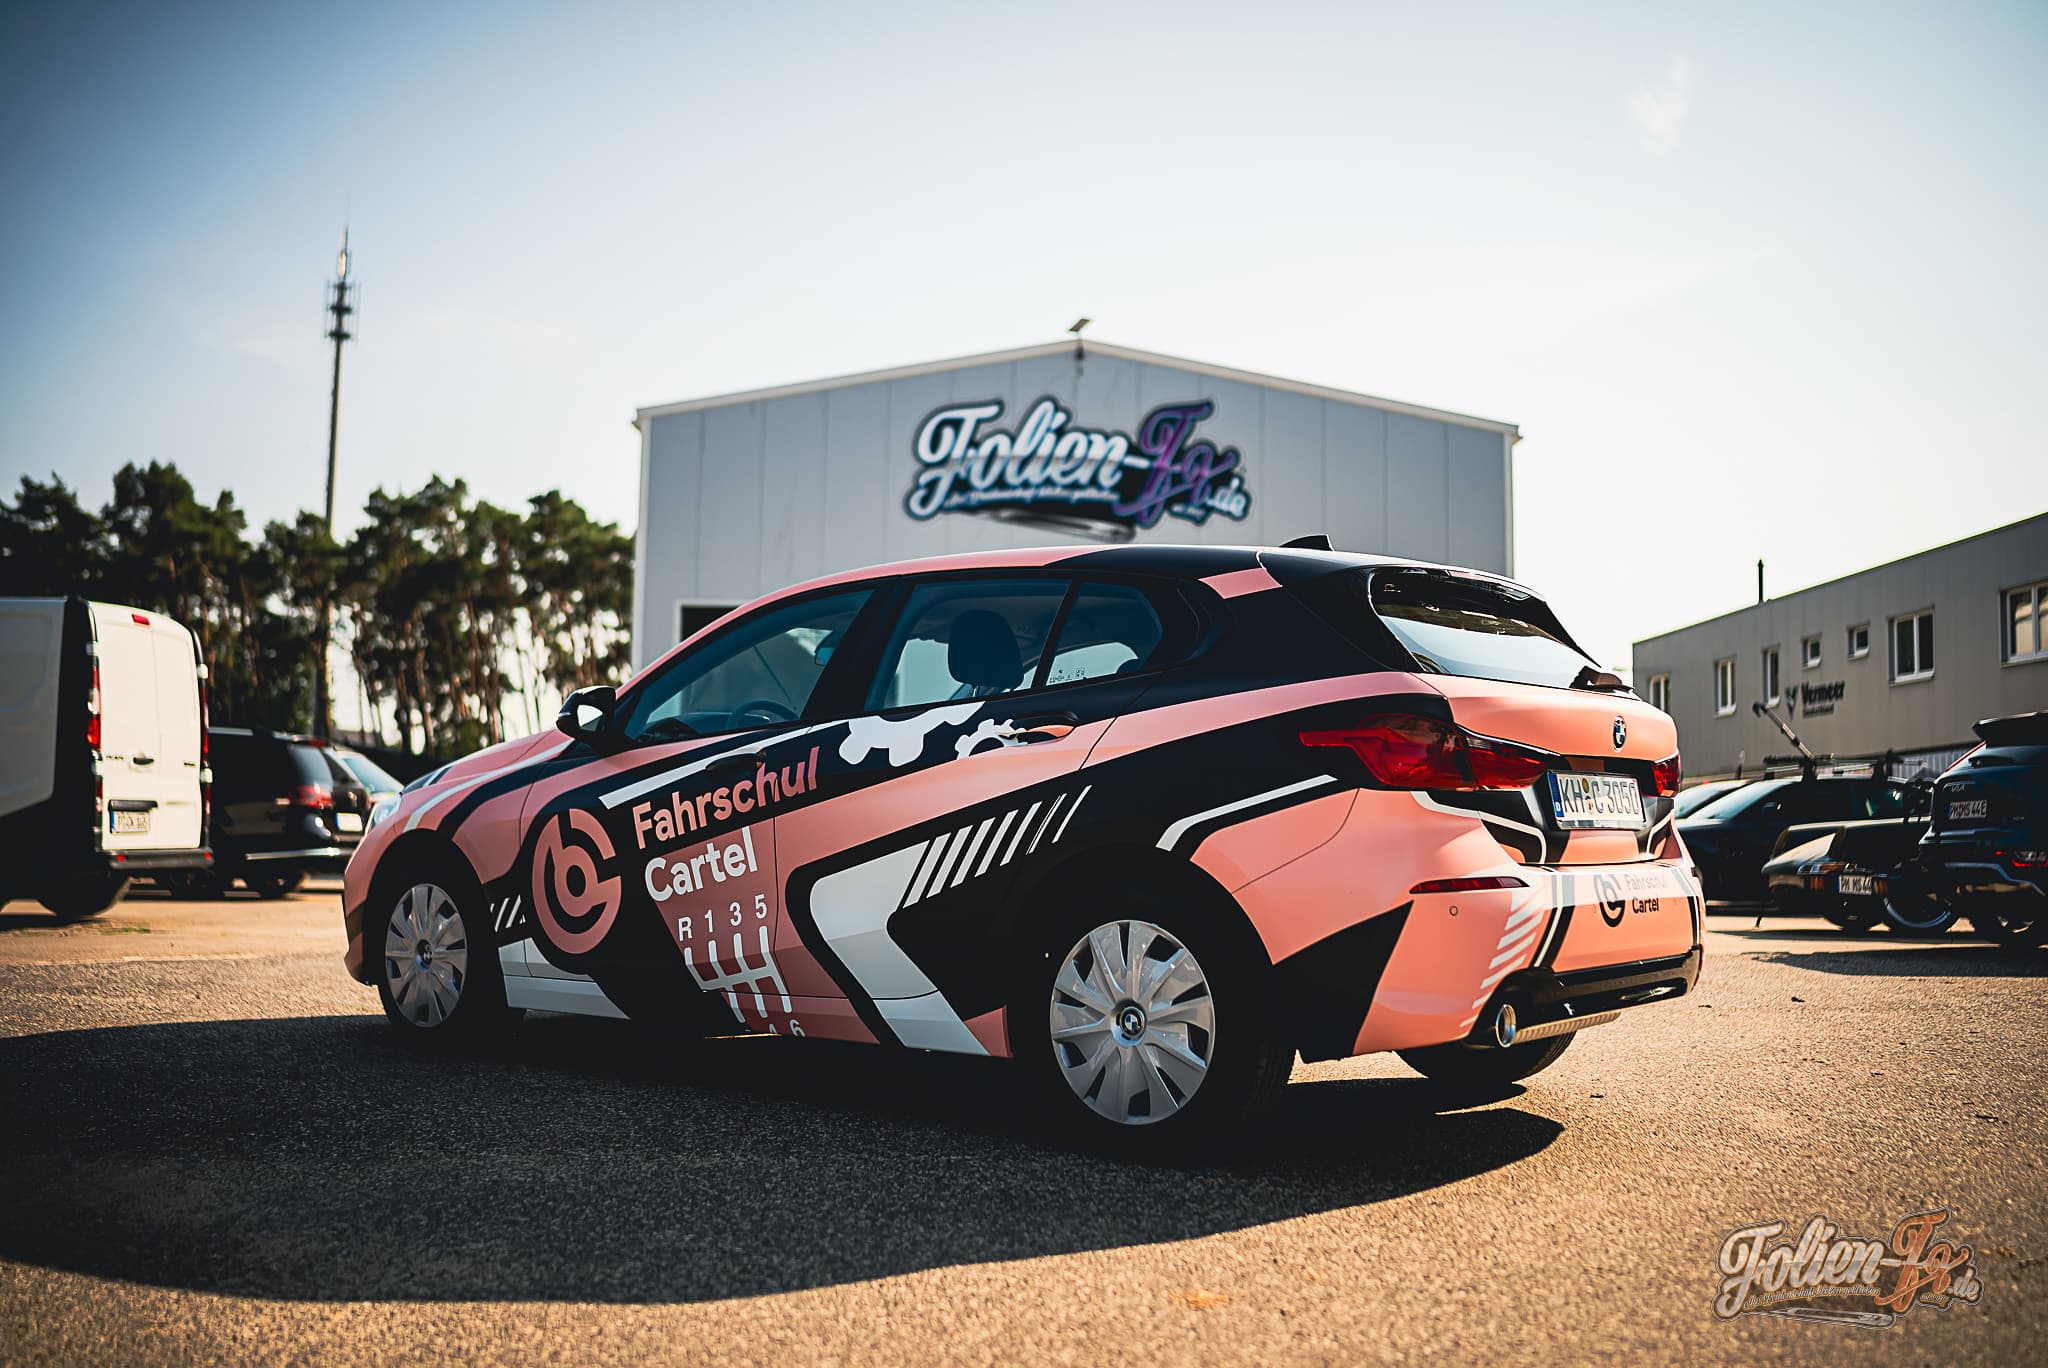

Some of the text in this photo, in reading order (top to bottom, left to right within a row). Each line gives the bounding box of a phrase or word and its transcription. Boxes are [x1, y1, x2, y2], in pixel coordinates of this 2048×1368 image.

[632, 746, 820, 849] Fahrschul
[1559, 779, 1640, 815] KH C 3050
[644, 826, 758, 901] Cartel
[678, 894, 767, 941] R 1 3 5
[1632, 897, 1659, 914] Cartel
